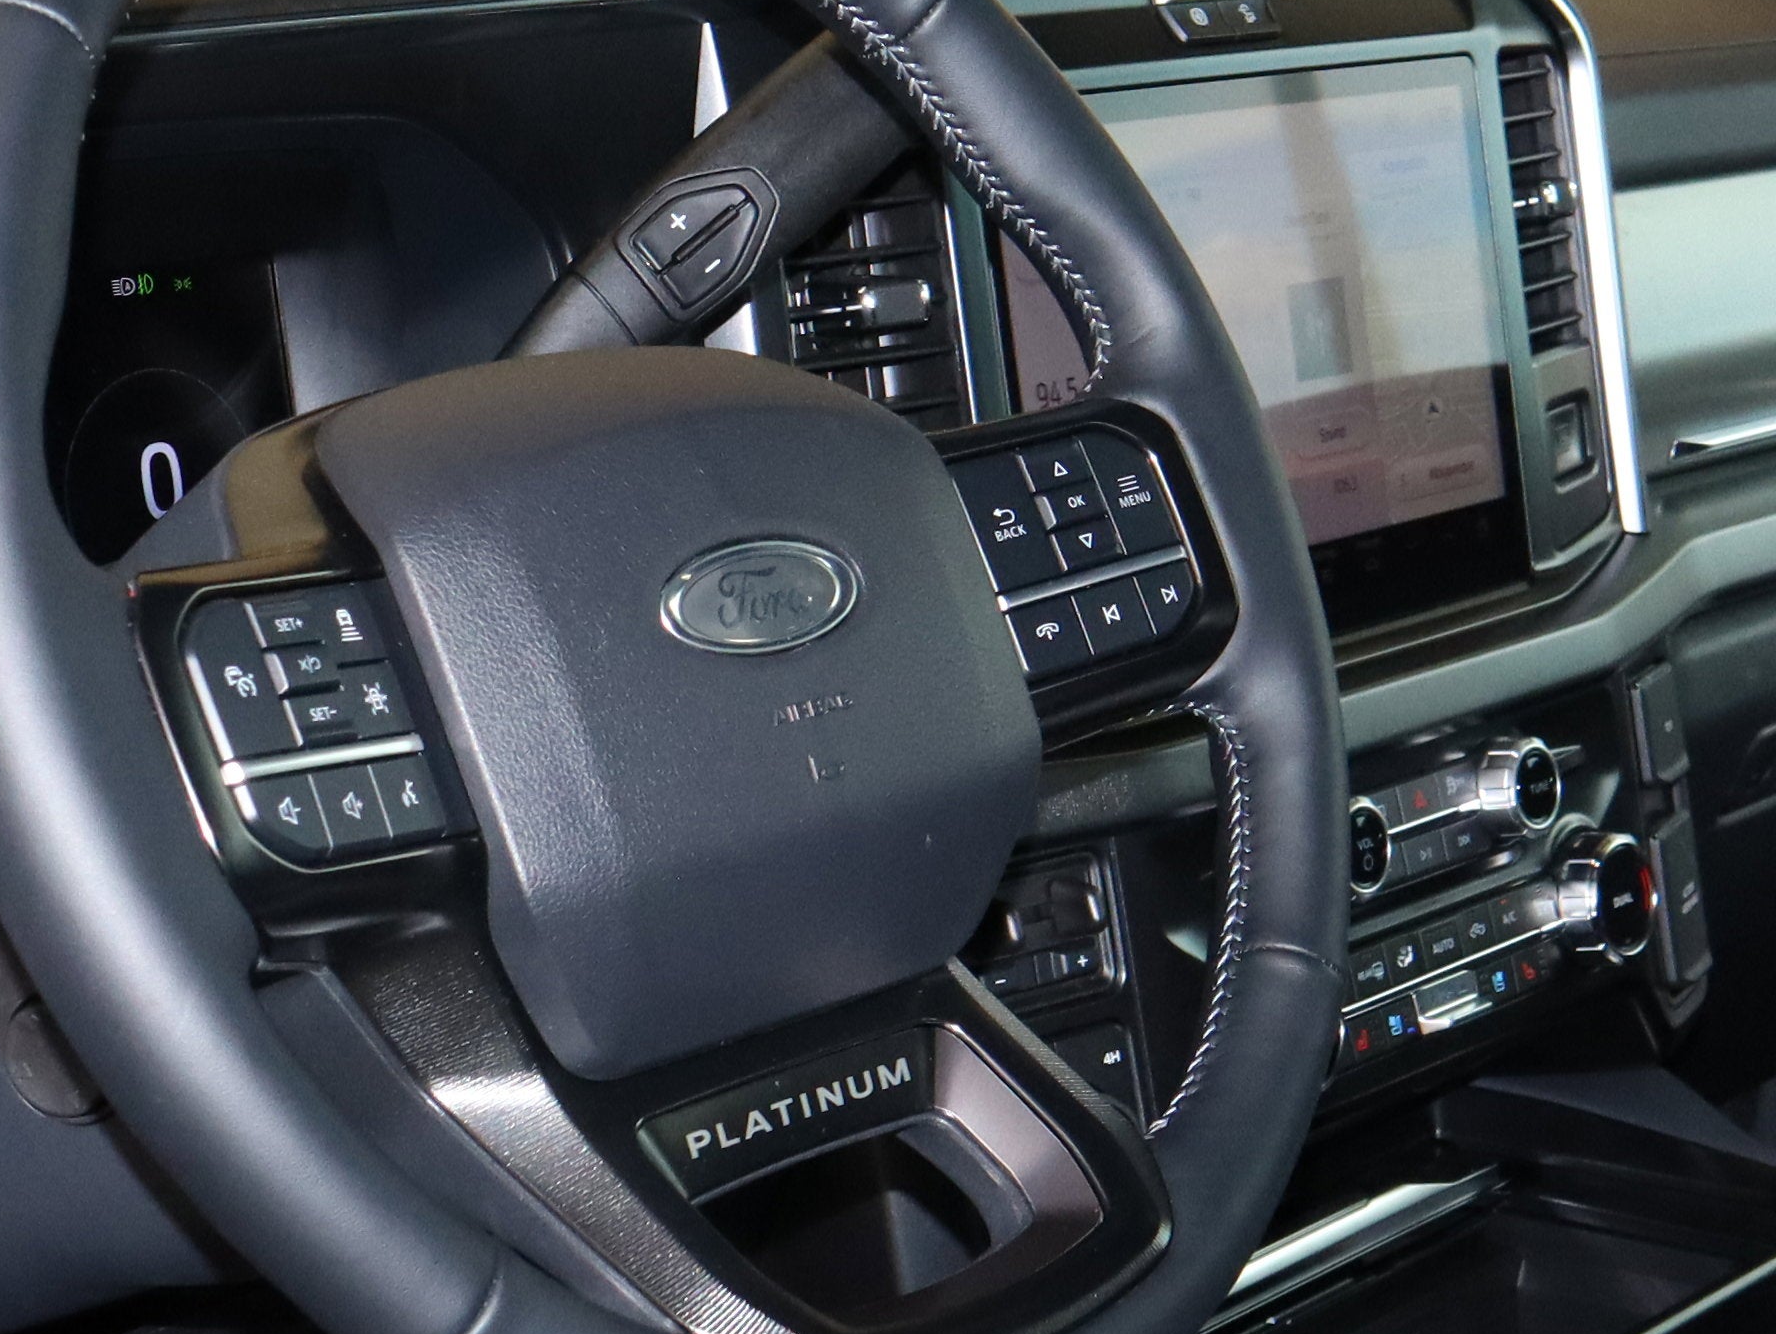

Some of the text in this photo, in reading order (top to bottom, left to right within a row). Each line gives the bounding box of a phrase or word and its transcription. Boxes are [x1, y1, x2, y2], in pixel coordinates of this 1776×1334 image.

[140, 441, 184, 520] 0
[1067, 494, 1086, 509] OK
[1117, 490, 1152, 509] MENU
[993, 523, 1027, 543] BACK
[685, 1056, 913, 1160] PLATINUM
